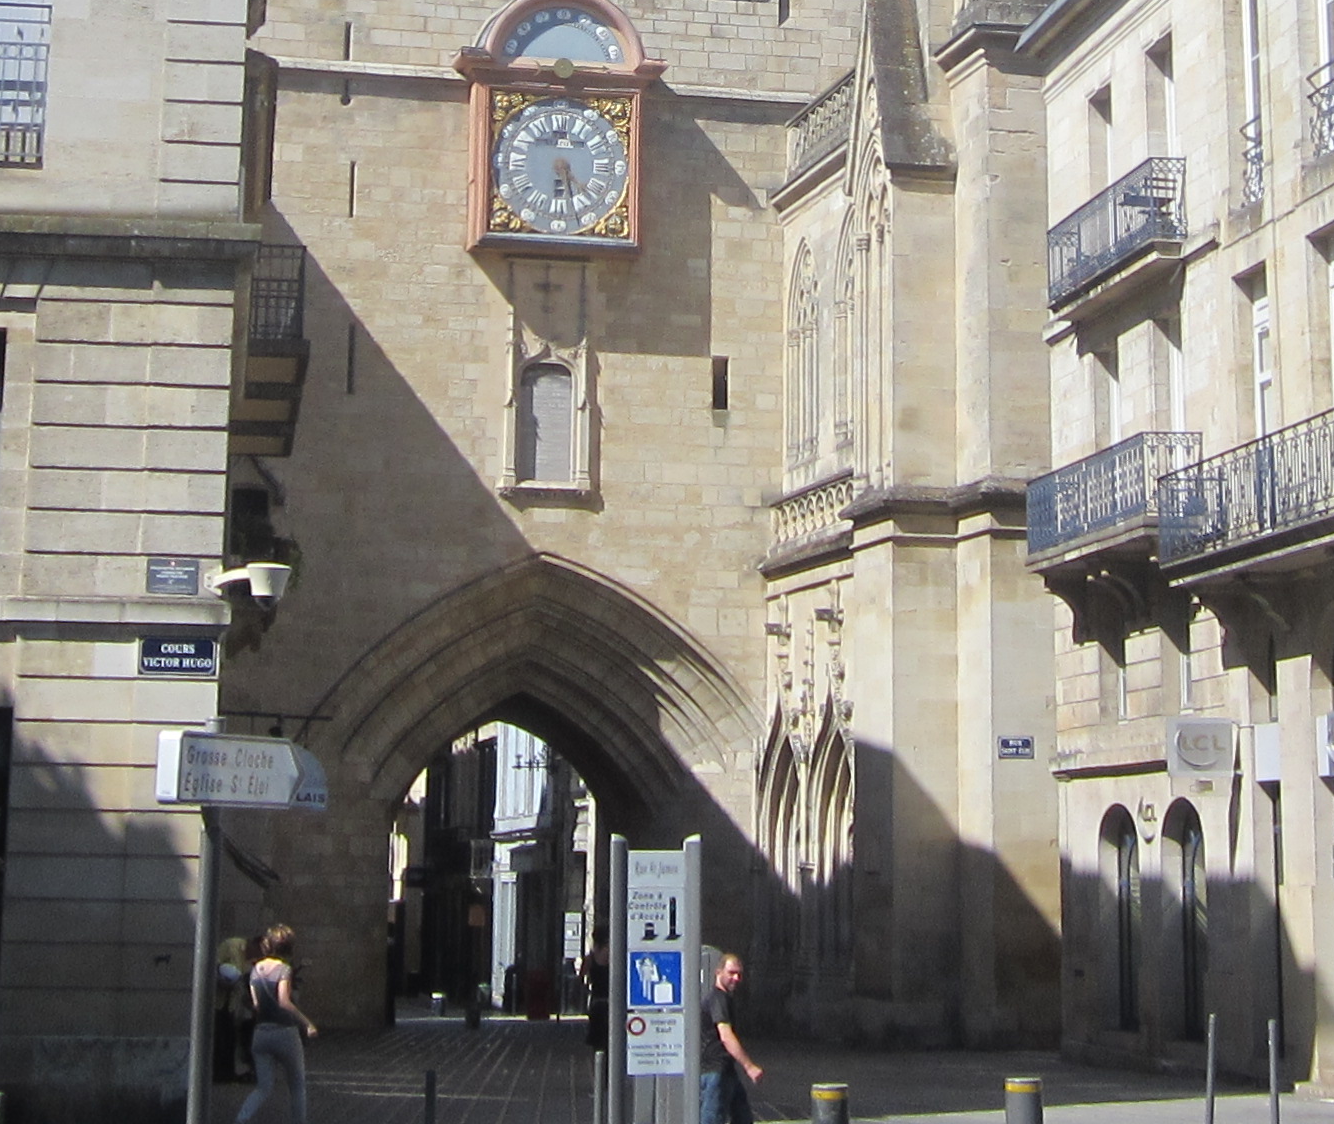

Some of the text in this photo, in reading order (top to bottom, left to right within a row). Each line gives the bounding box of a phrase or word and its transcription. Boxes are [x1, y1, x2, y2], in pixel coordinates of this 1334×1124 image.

[160, 643, 196, 654] COURS
[143, 657, 212, 669] VICTOR HUGO
[1180, 733, 1227, 752] LCL
[186, 745, 274, 770] Grosse Cloche
[296, 793, 326, 803] LAIS
